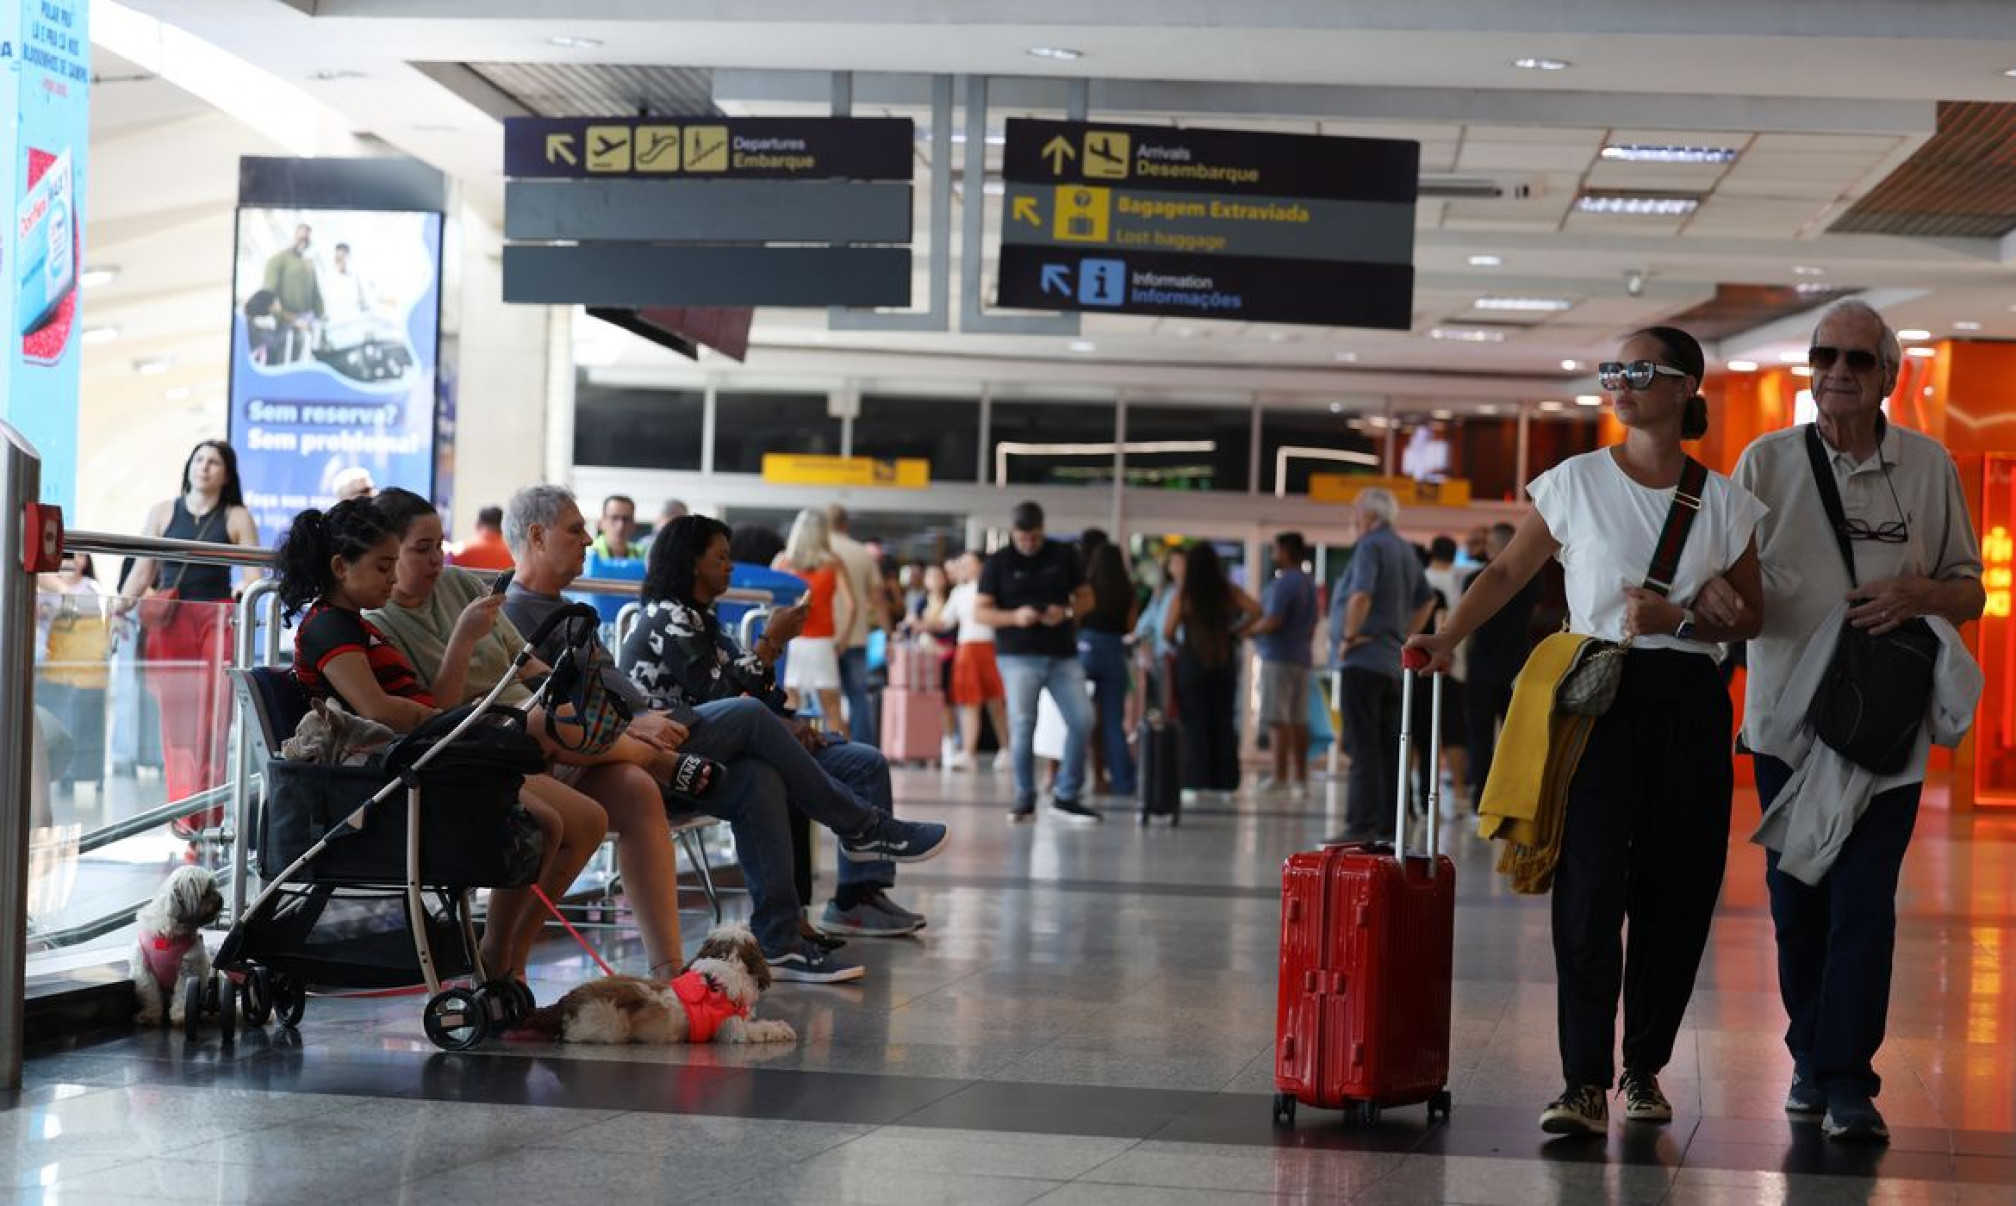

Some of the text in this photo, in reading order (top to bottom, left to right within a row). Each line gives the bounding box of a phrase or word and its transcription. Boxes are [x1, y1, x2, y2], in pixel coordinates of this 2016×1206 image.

[733, 135, 805, 152] Departures
[1136, 144, 1191, 161] Arrivals
[733, 152, 815, 172] Embarque
[1136, 160, 1259, 185] Desembarque
[1118, 195, 1310, 223] Bagagem Extraviada
[1116, 228, 1227, 252] Lost baggage
[1132, 272, 1213, 289] Information
[1132, 287, 1242, 310] Informações
[249, 399, 398, 425] Sem reserva?
[248, 427, 297, 450] Sem
[675, 755, 701, 792] VANS
